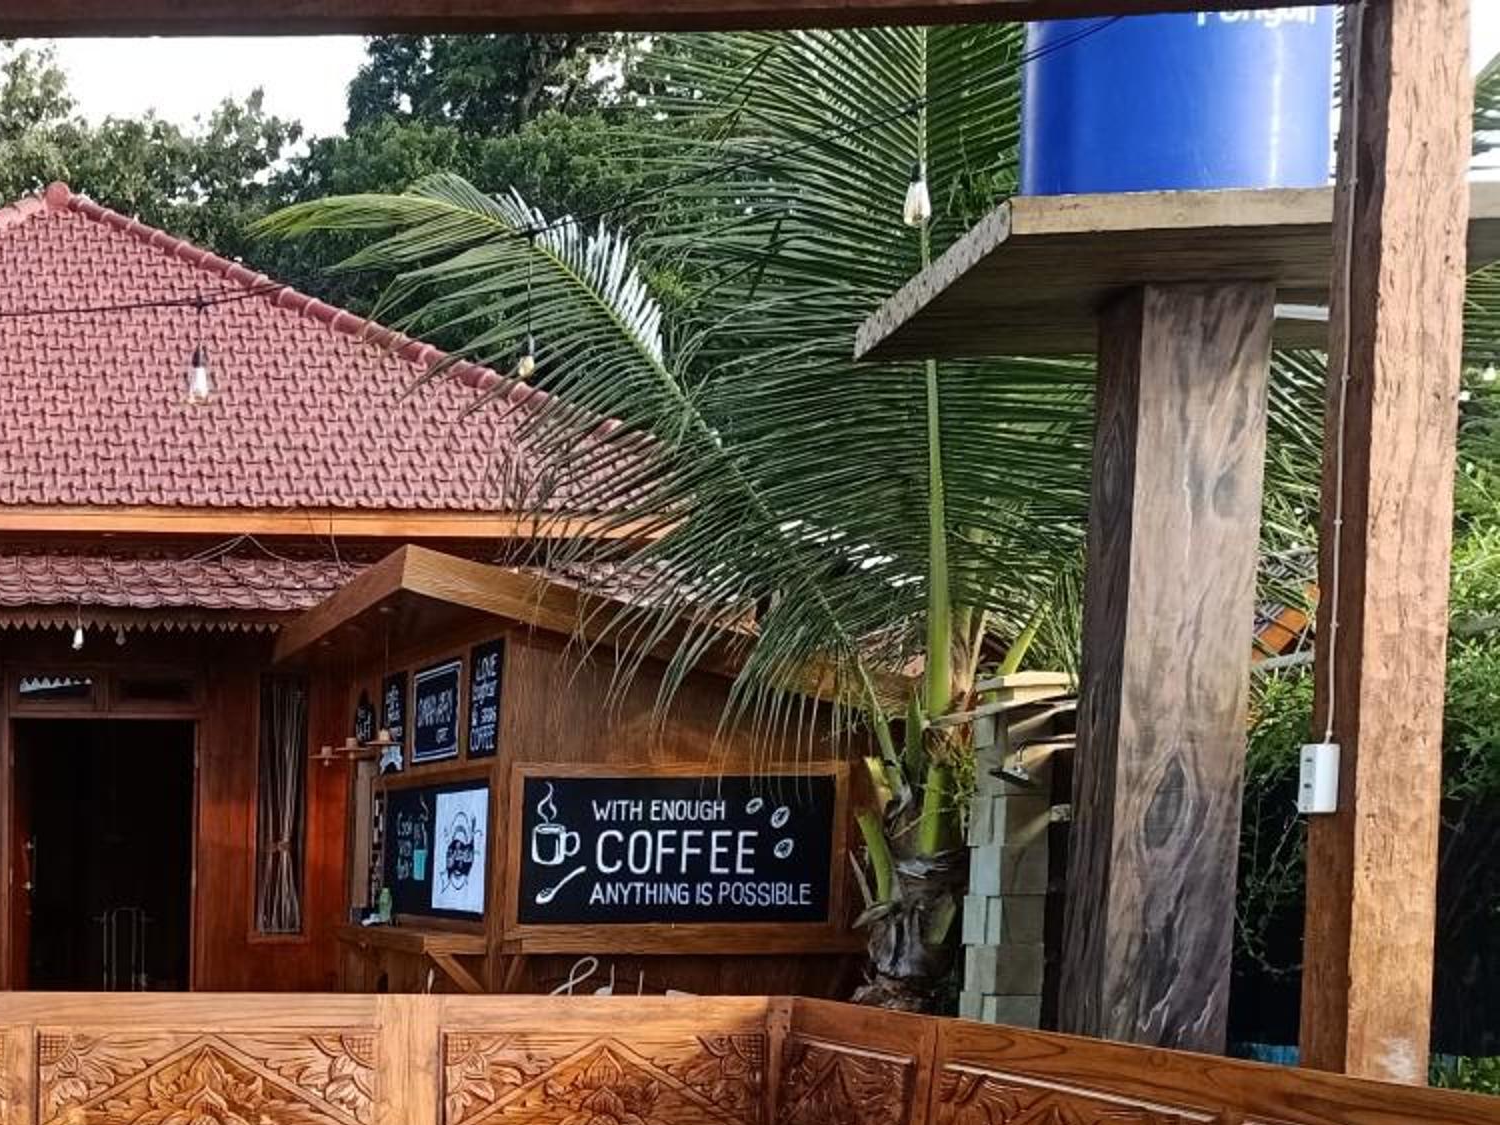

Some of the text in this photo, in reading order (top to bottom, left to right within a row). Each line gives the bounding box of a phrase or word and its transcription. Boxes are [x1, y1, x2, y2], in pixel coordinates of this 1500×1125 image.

[592, 800, 726, 821] WITH ENOUGH
[596, 830, 758, 874] COFFEE
[589, 882, 812, 905] ANYTHING IS POSSIBLE
